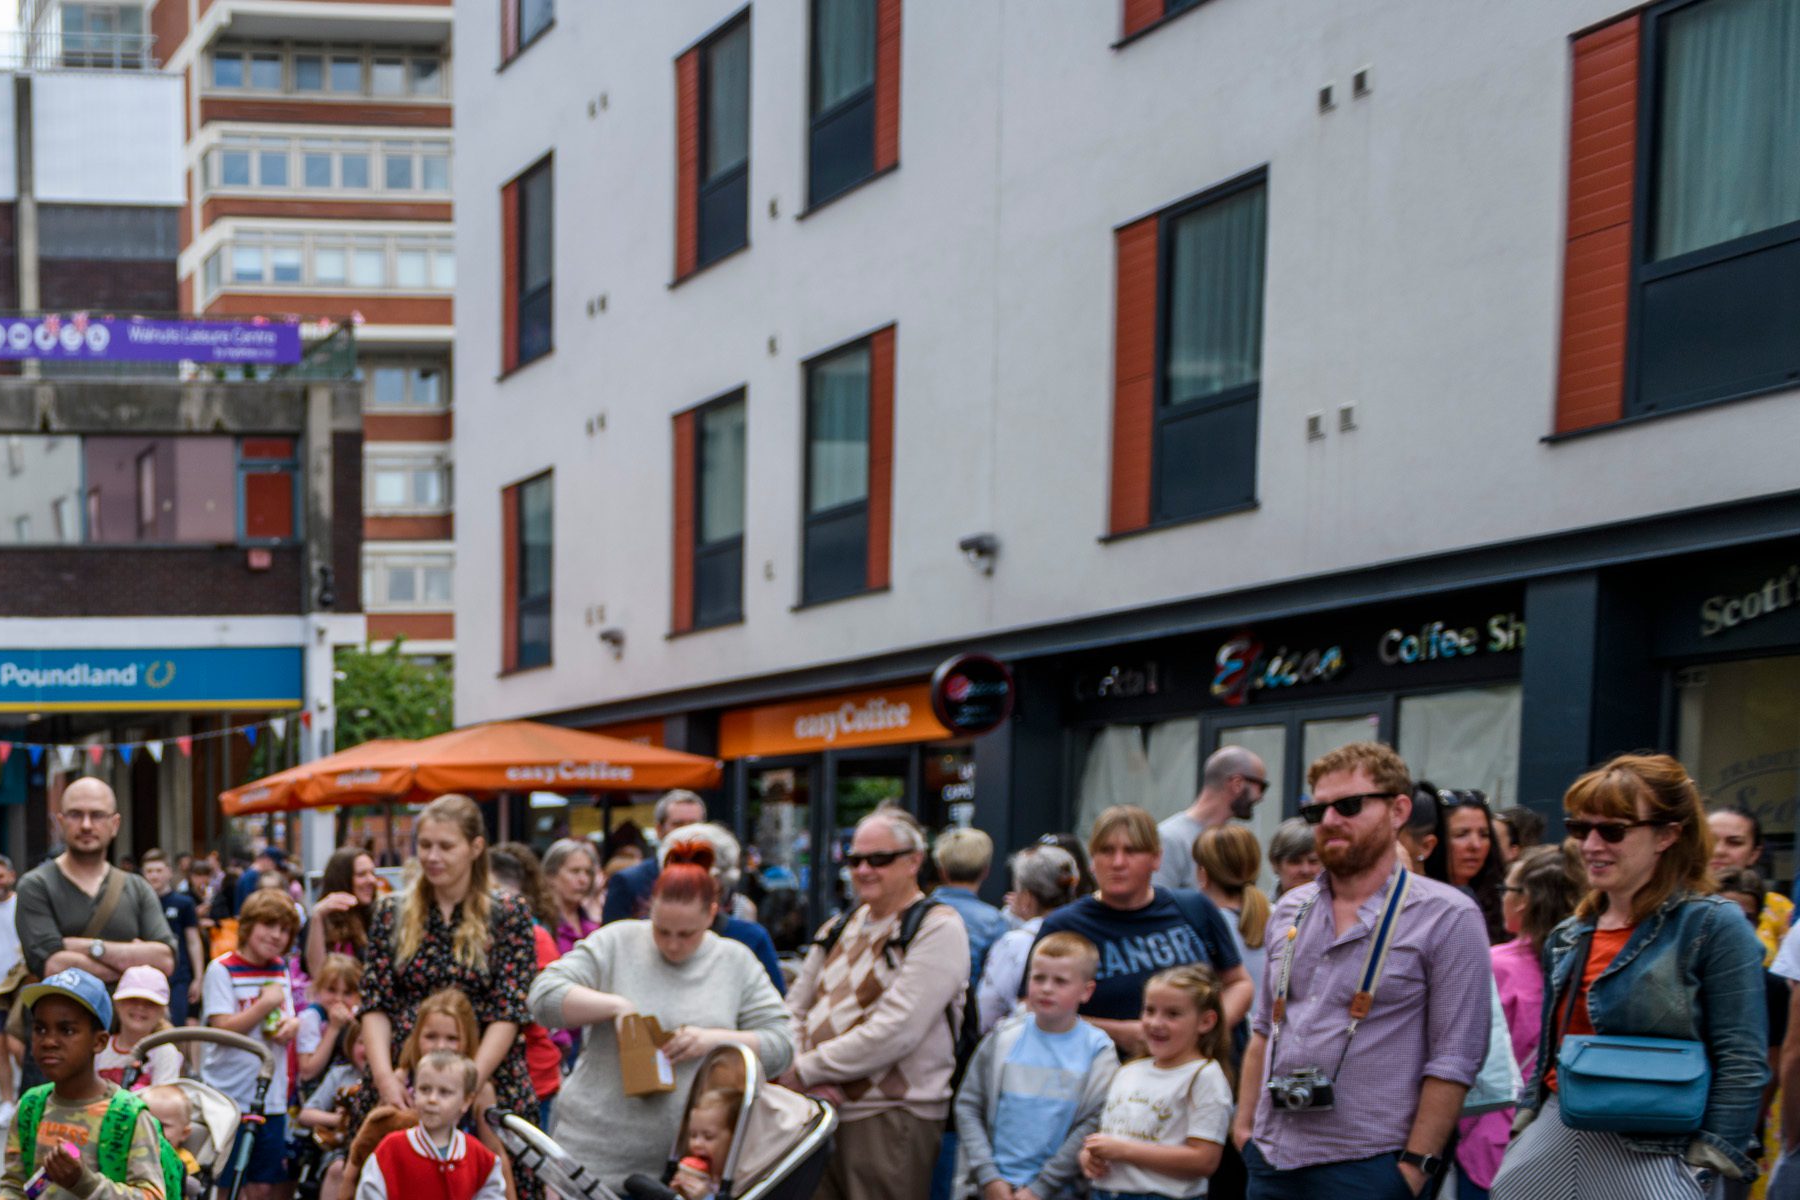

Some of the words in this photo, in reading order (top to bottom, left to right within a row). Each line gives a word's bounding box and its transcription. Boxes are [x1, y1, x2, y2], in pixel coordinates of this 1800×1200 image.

[1701, 564, 1800, 637] Scott'
[1378, 620, 1479, 666] Coffee
[0, 661, 138, 688] Poundland
[794, 697, 911, 743] easyCoffee
[505, 759, 634, 784] easyCoffee
